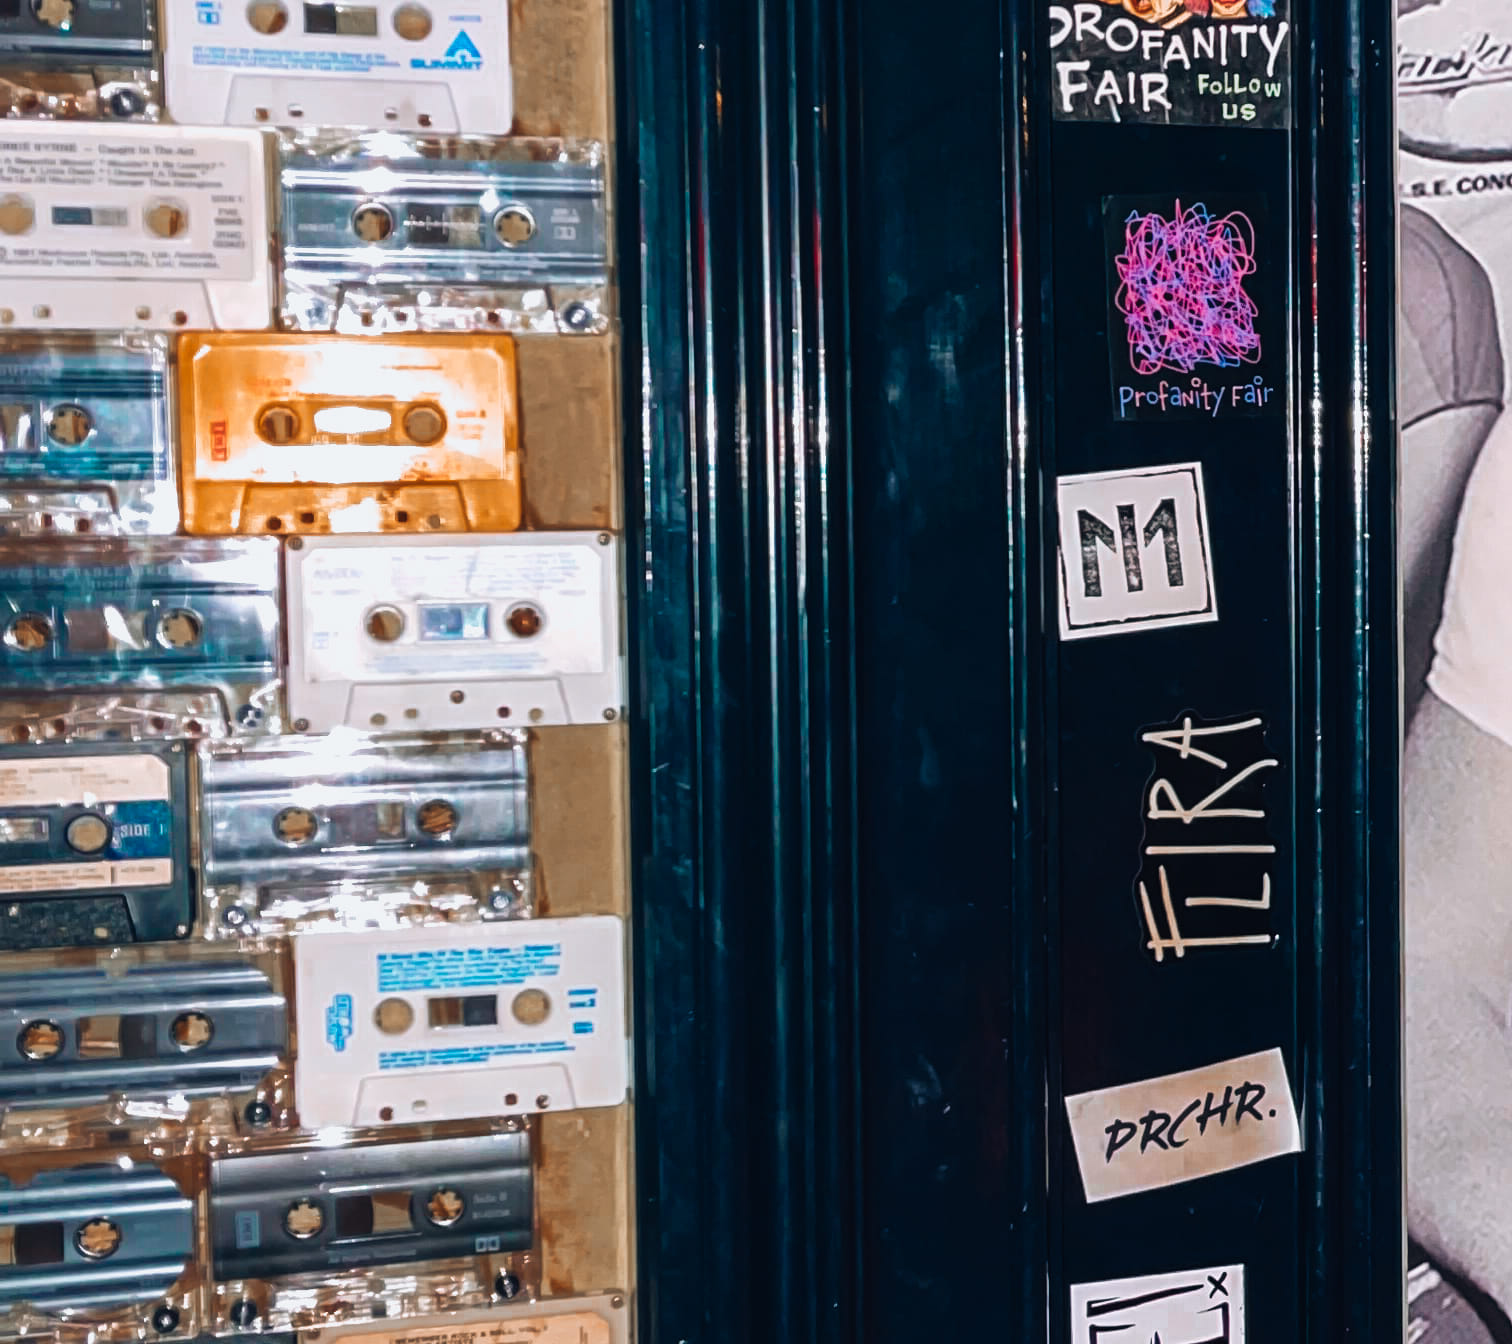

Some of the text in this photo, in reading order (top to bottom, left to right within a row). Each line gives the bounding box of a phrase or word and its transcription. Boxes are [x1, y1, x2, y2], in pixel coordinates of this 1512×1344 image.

[410, 58, 483, 70] SUMMIT
[1056, 60, 1172, 112] FAIR
[1232, 375, 1274, 407] Fair
[120, 823, 151, 837] SIDE
